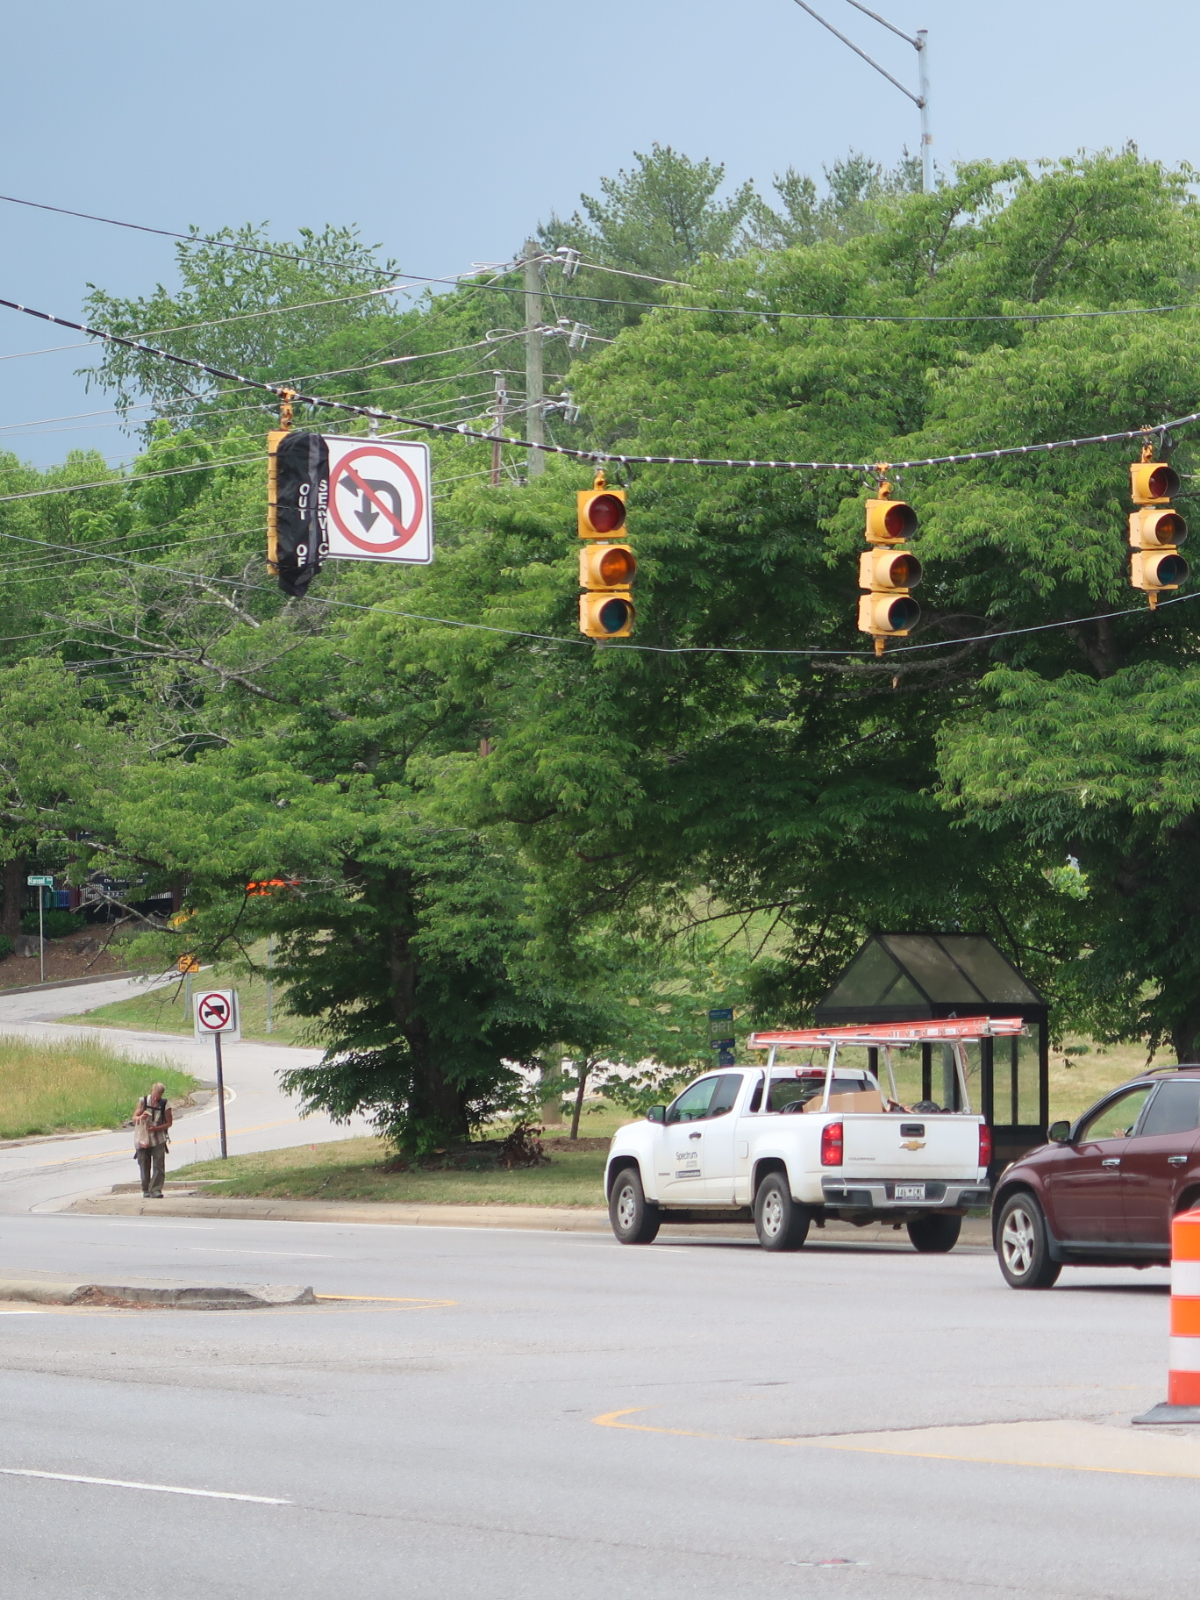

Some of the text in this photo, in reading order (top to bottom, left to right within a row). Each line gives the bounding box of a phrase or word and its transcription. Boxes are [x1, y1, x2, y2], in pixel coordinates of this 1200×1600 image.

[296, 483, 310, 567] OUT OF
[675, 1151, 698, 1163] Spectrum
